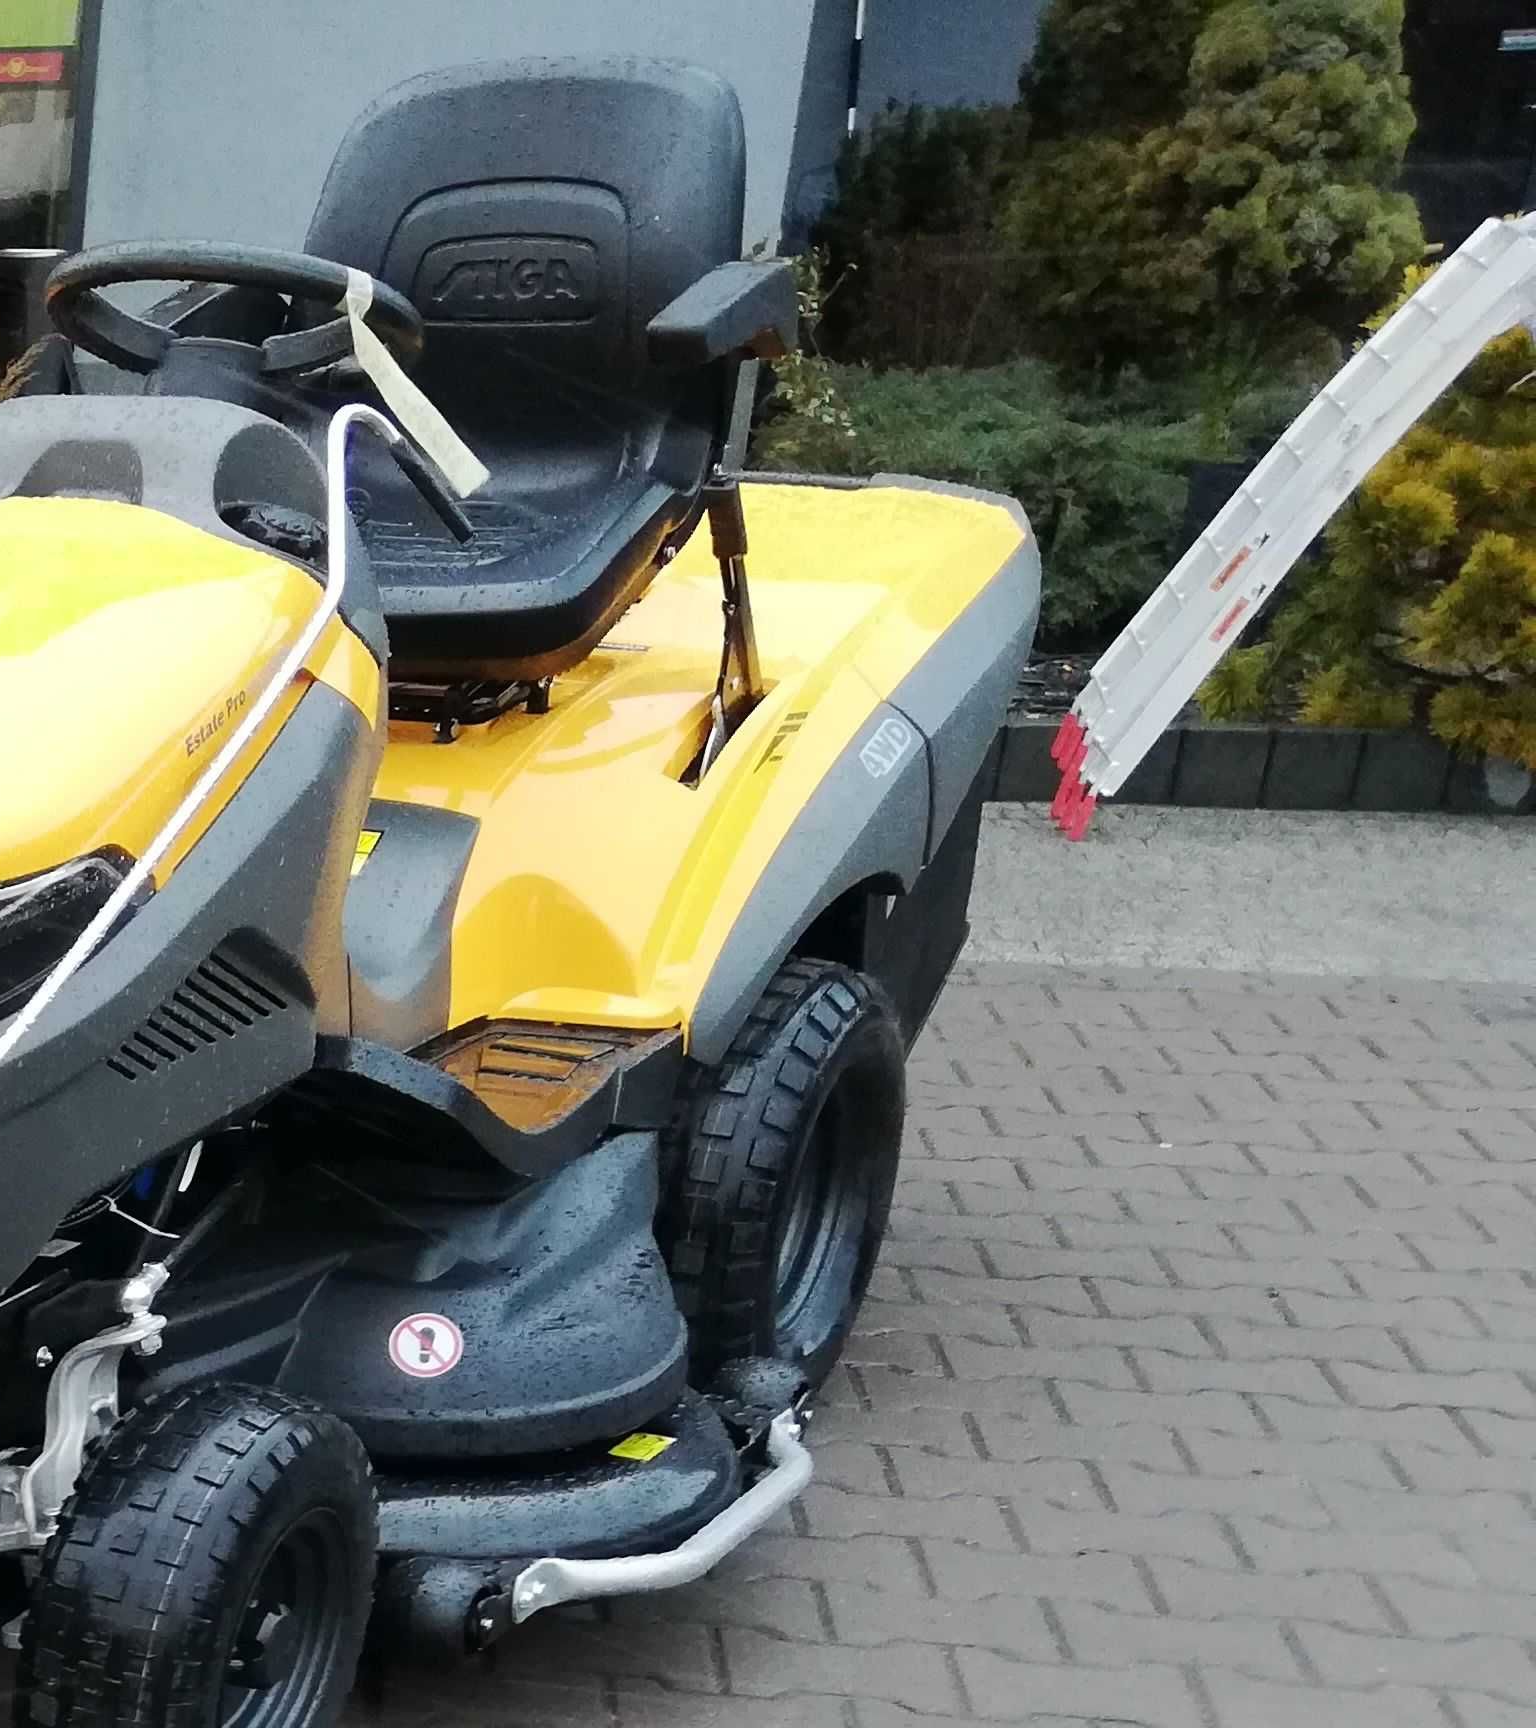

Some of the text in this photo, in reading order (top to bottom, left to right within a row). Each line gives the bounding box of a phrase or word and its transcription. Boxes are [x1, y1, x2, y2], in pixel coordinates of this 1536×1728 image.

[433, 258, 580, 301] STIGA
[184, 690, 247, 756] Estate Pro
